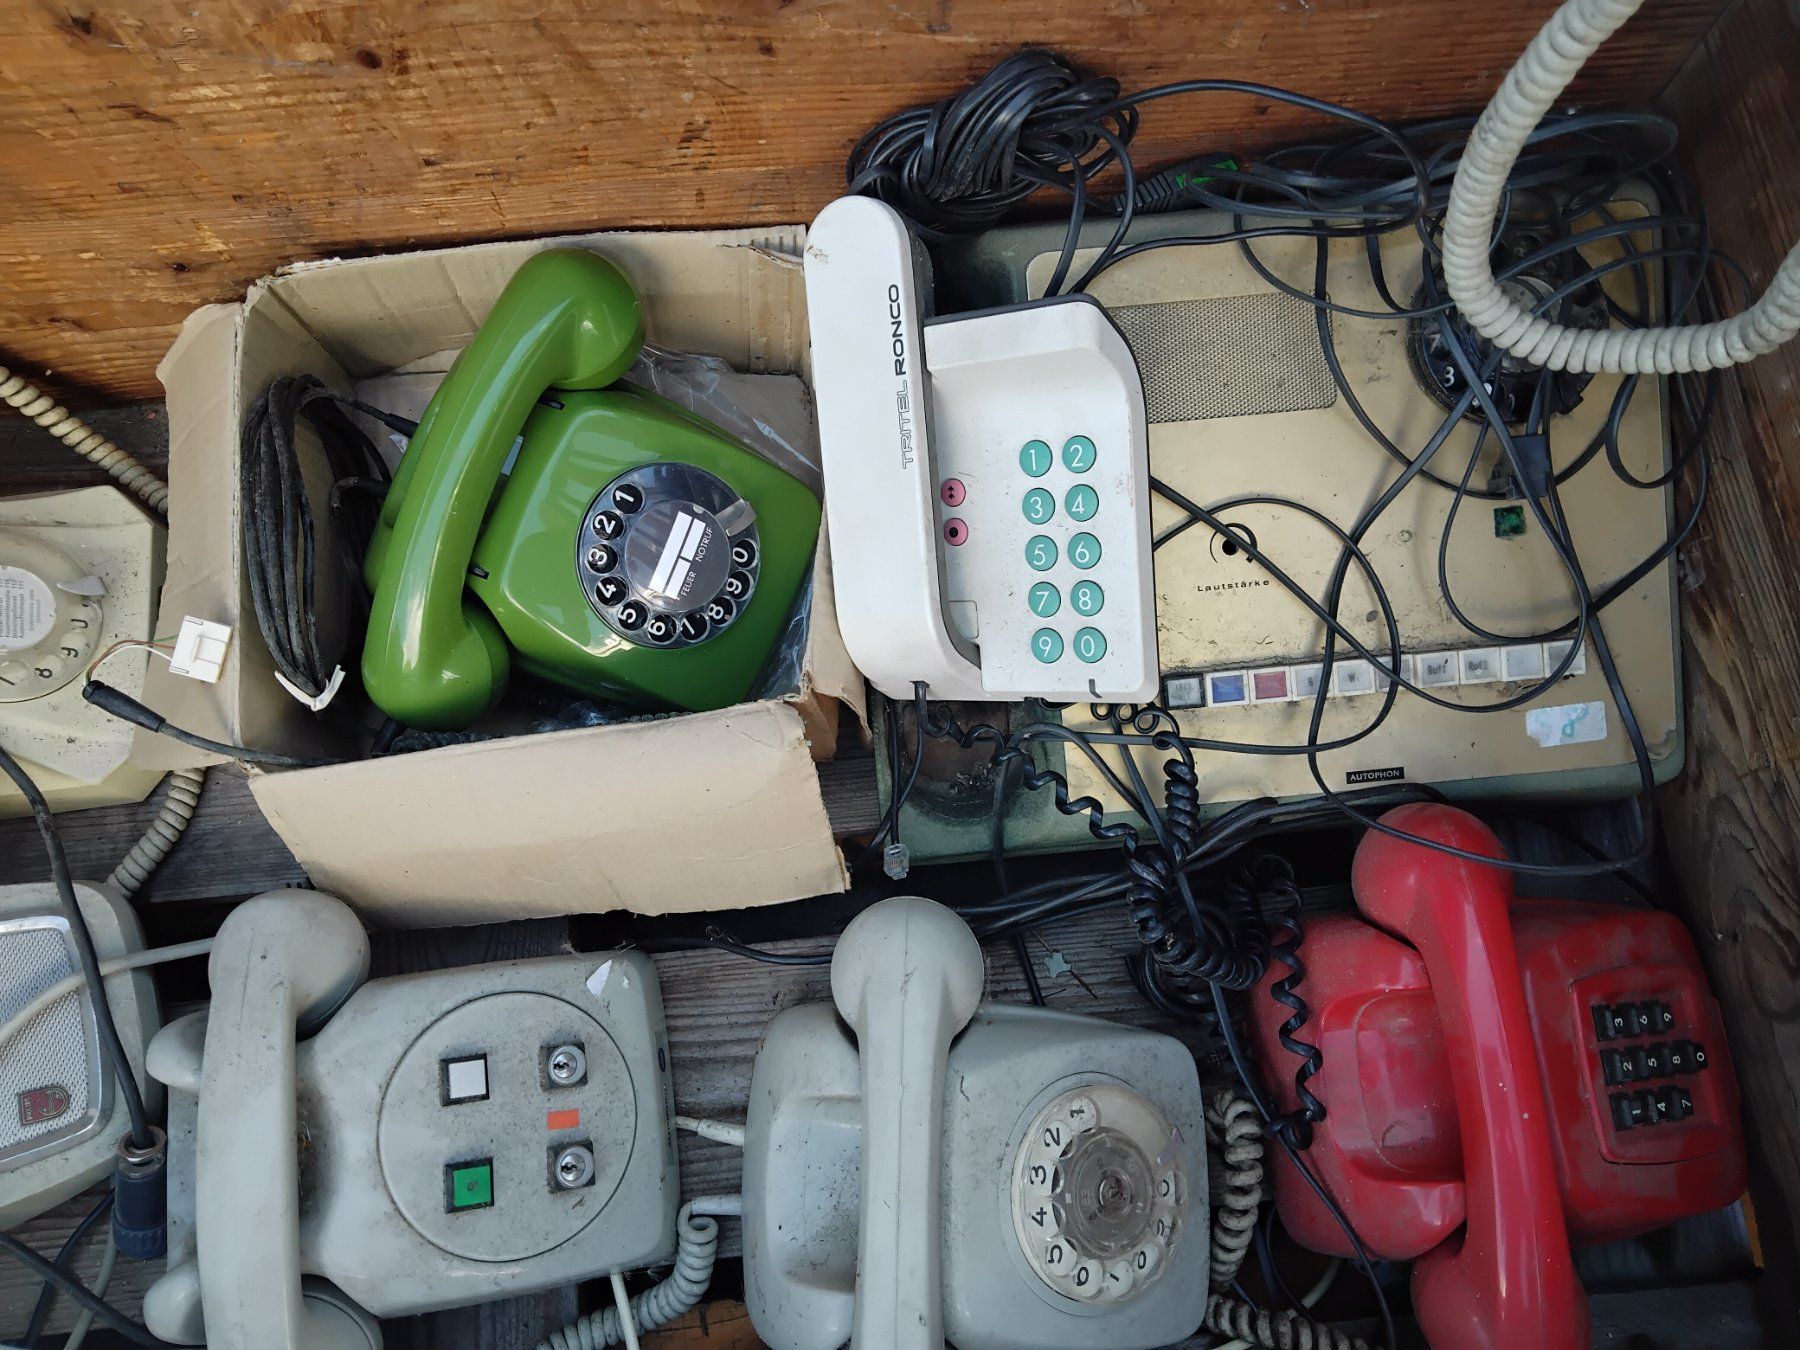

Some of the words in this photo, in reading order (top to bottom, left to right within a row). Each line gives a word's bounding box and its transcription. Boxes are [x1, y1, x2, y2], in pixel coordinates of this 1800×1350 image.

[888, 284, 907, 376] RONCO
[897, 379, 913, 469] TRITEL
[1029, 449, 1038, 471] 1
[1070, 444, 1084, 467] 2
[615, 489, 634, 503] 1
[1071, 492, 1085, 514] 4
[1030, 496, 1044, 519] 3
[594, 515, 616, 529] 2
[695, 526, 713, 562] NOTRUF
[1075, 538, 1090, 561] 6
[587, 548, 608, 565] 3
[732, 547, 749, 562] 0
[1033, 544, 1046, 566] 5
[598, 583, 617, 599] 4
[681, 571, 697, 597] FEUER
[726, 580, 743, 594] 9
[1197, 580, 1270, 592] Lautstärke
[1036, 592, 1049, 613] 7
[1078, 587, 1091, 610] 8
[618, 608, 637, 624] 5
[708, 603, 724, 620] 8
[649, 621, 666, 636] 6
[1039, 636, 1051, 658] 9
[1081, 635, 1095, 657] 0
[1350, 770, 1400, 781] AUTOPHON
[1614, 1017, 1624, 1027] 3
[1639, 1015, 1648, 1024] 6
[1663, 1012, 1672, 1022] 9
[1648, 1058, 1657, 1067] 5
[1672, 1055, 1681, 1064] 8
[1696, 1052, 1705, 1062] 0
[1622, 1061, 1632, 1071] 2
[1657, 1101, 1666, 1111] 4
[1682, 1099, 1691, 1108] 7
[1069, 1108, 1085, 1118] 1
[1043, 1127, 1060, 1148] 2
[1030, 1165, 1047, 1185] 3
[1031, 1206, 1048, 1227] 4
[1047, 1244, 1063, 1264] 5
